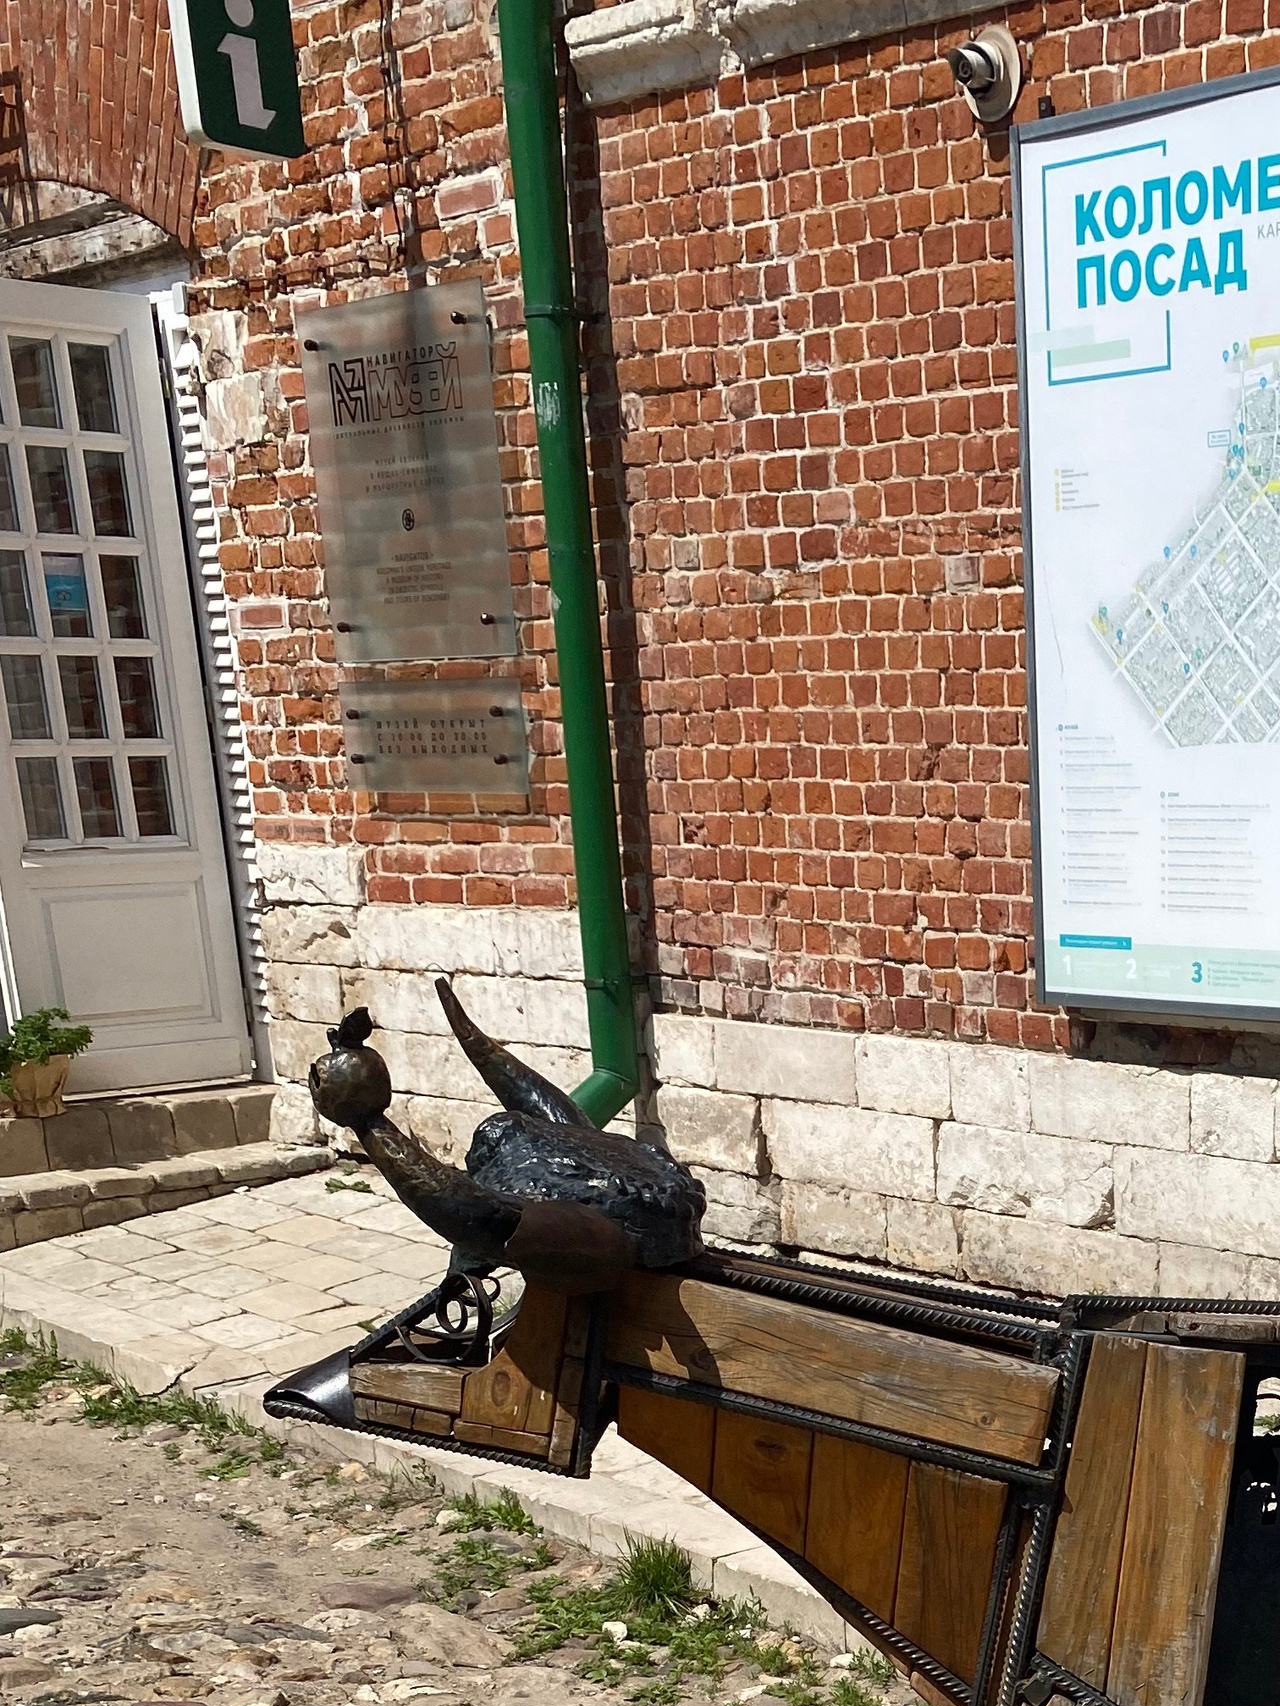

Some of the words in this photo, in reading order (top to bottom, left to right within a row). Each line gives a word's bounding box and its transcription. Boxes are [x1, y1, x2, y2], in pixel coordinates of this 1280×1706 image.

[1077, 229, 1248, 309] ПОСАД
[366, 346, 434, 368] НАВИГАТОР
[377, 717, 419, 729] МУЗЕЙ
[430, 719, 485, 729] ОТКРЫТ
[431, 732, 445, 742] ДО
[379, 745, 401, 754] БЕЗ
[412, 744, 488, 754] ВЫХОДНЫХ
[1062, 955, 1072, 976] 1
[1126, 958, 1138, 979] 2
[1191, 961, 1203, 984] 3
